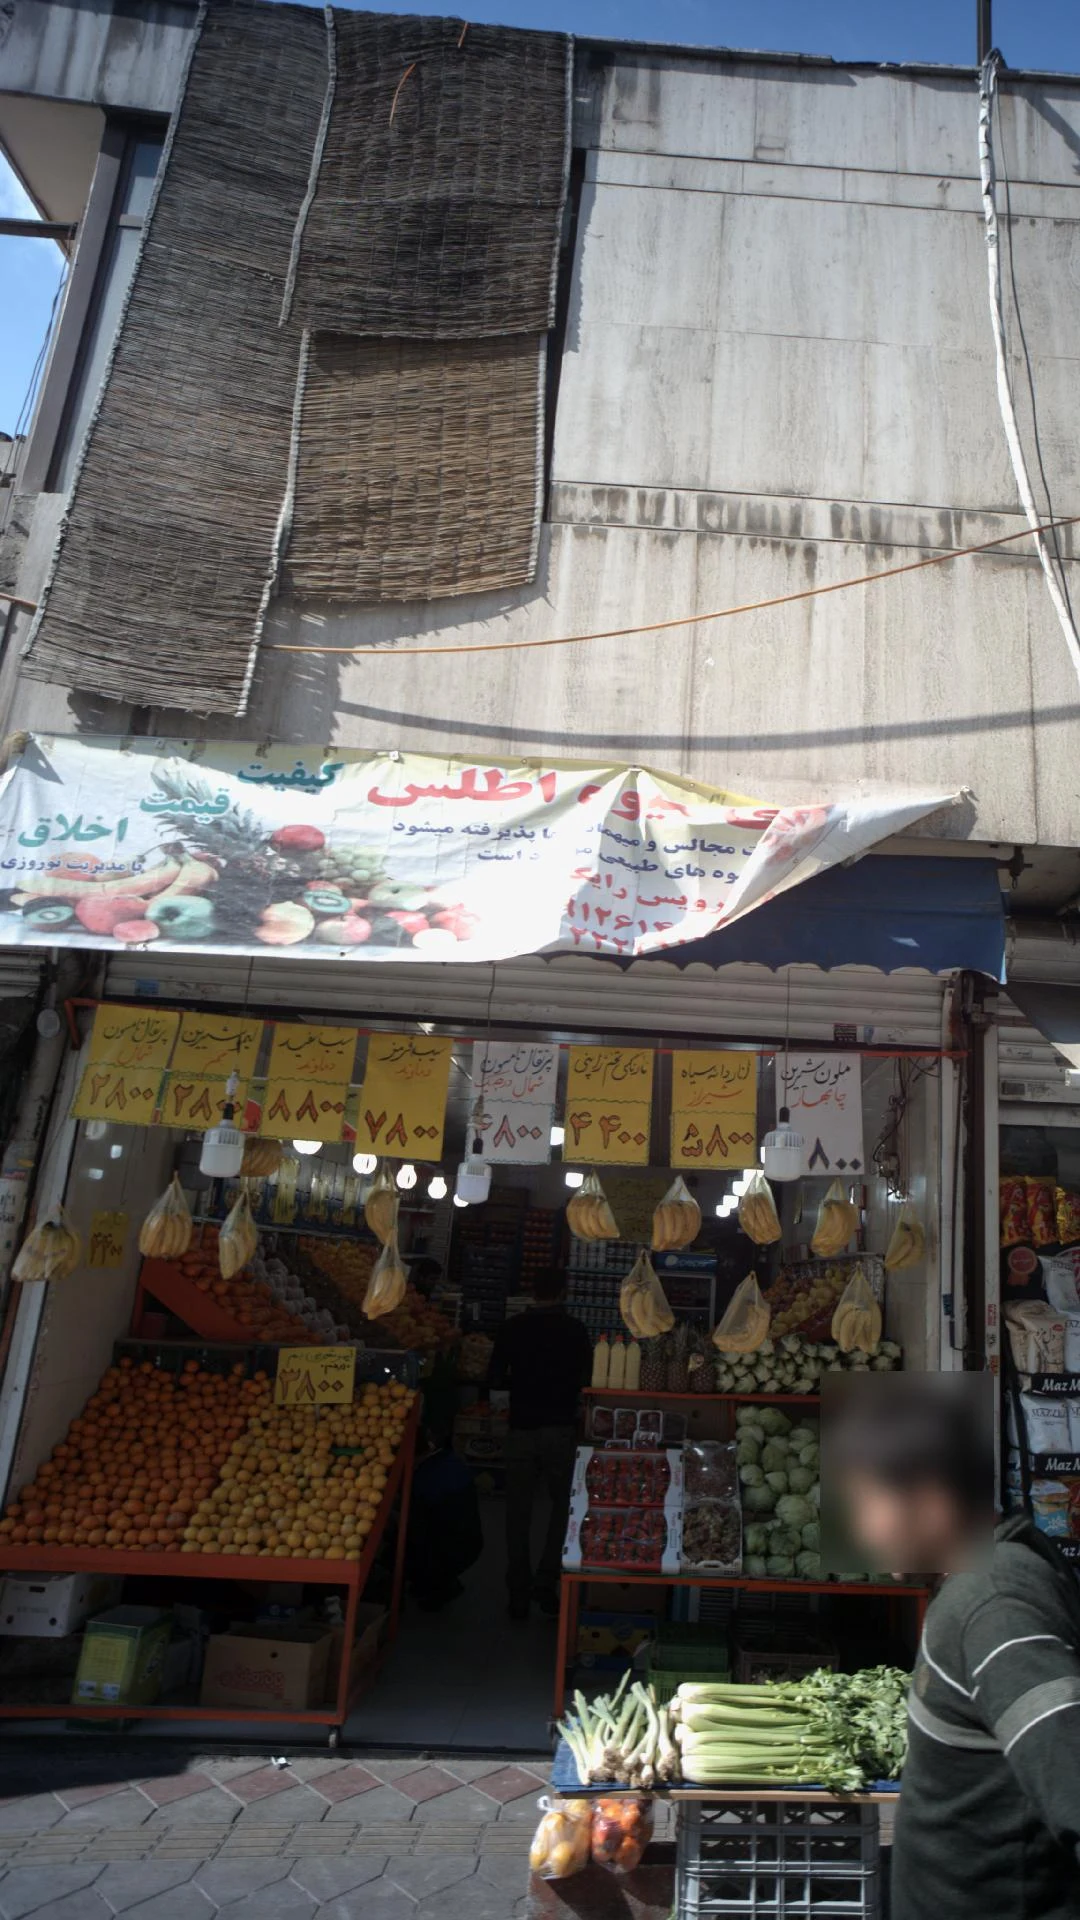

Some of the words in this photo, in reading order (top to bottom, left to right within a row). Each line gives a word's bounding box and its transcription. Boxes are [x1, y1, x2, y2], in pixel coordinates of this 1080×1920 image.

[237, 760, 345, 790] کیفیت
[367, 767, 557, 807] اطلس
[139, 788, 231, 823] قیمت
[17, 813, 129, 848] اخلاق
[392, 820, 455, 837] میشود
[460, 821, 536, 843] پذیرفته
[645, 841, 657, 852] و
[663, 838, 735, 857] مجالس
[1, 857, 62, 871] نوروزی
[66, 859, 125, 874] مدیریت
[598, 852, 659, 874] طبیعی
[664, 863, 706, 879] های
[636, 890, 724, 912] رویس
[514, 1047, 554, 1075] پرتقال
[268, 1088, 346, 1124] ۸۸۰۰
[687, 1083, 744, 1108] شیراز
[364, 1109, 440, 1148] ۷۸۰۰
[569, 1111, 647, 1150] ۴۴۰۰
[807, 1136, 862, 1171] ۸۰۰
[1041, 1378, 1068, 1391] Maz
[1045, 1457, 1071, 1471] Maz
